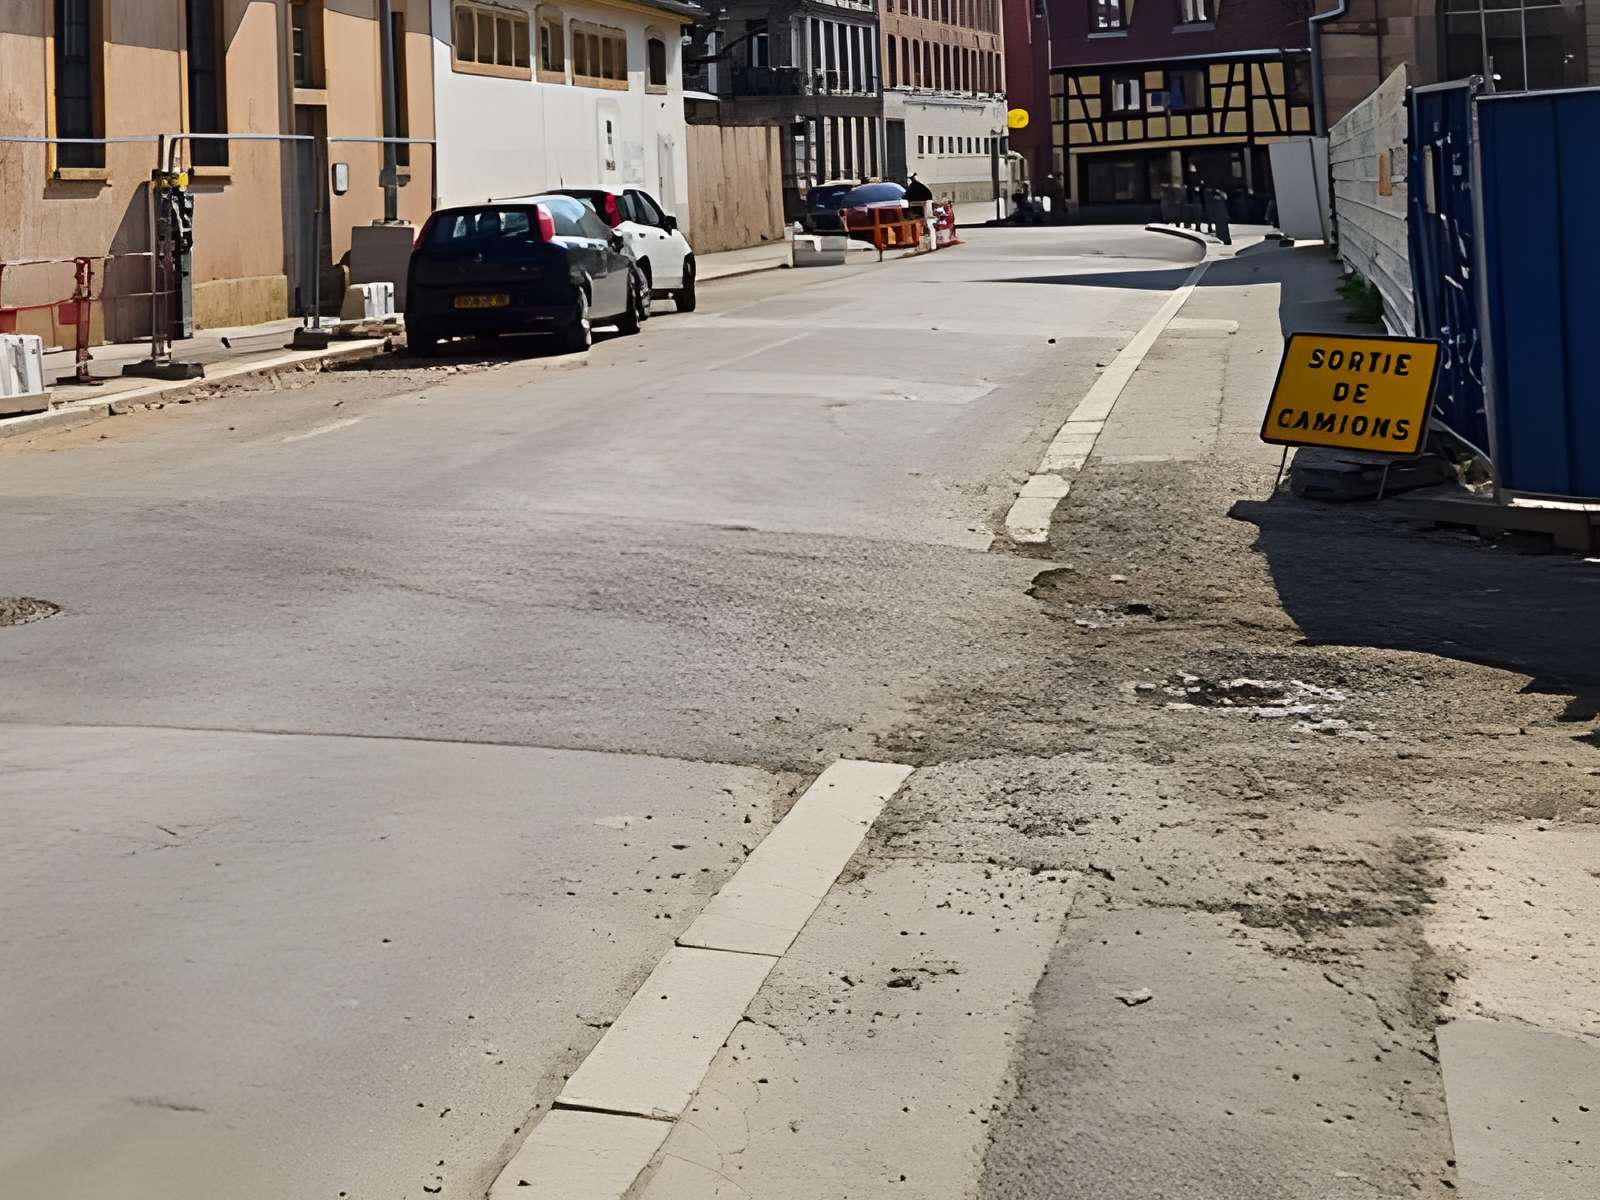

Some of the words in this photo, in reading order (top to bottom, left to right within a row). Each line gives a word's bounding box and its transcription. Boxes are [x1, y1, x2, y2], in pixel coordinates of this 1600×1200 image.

[1308, 348, 1413, 376] SORTIE
[1333, 382, 1370, 404] DE
[1277, 408, 1411, 441] CAMIONS
